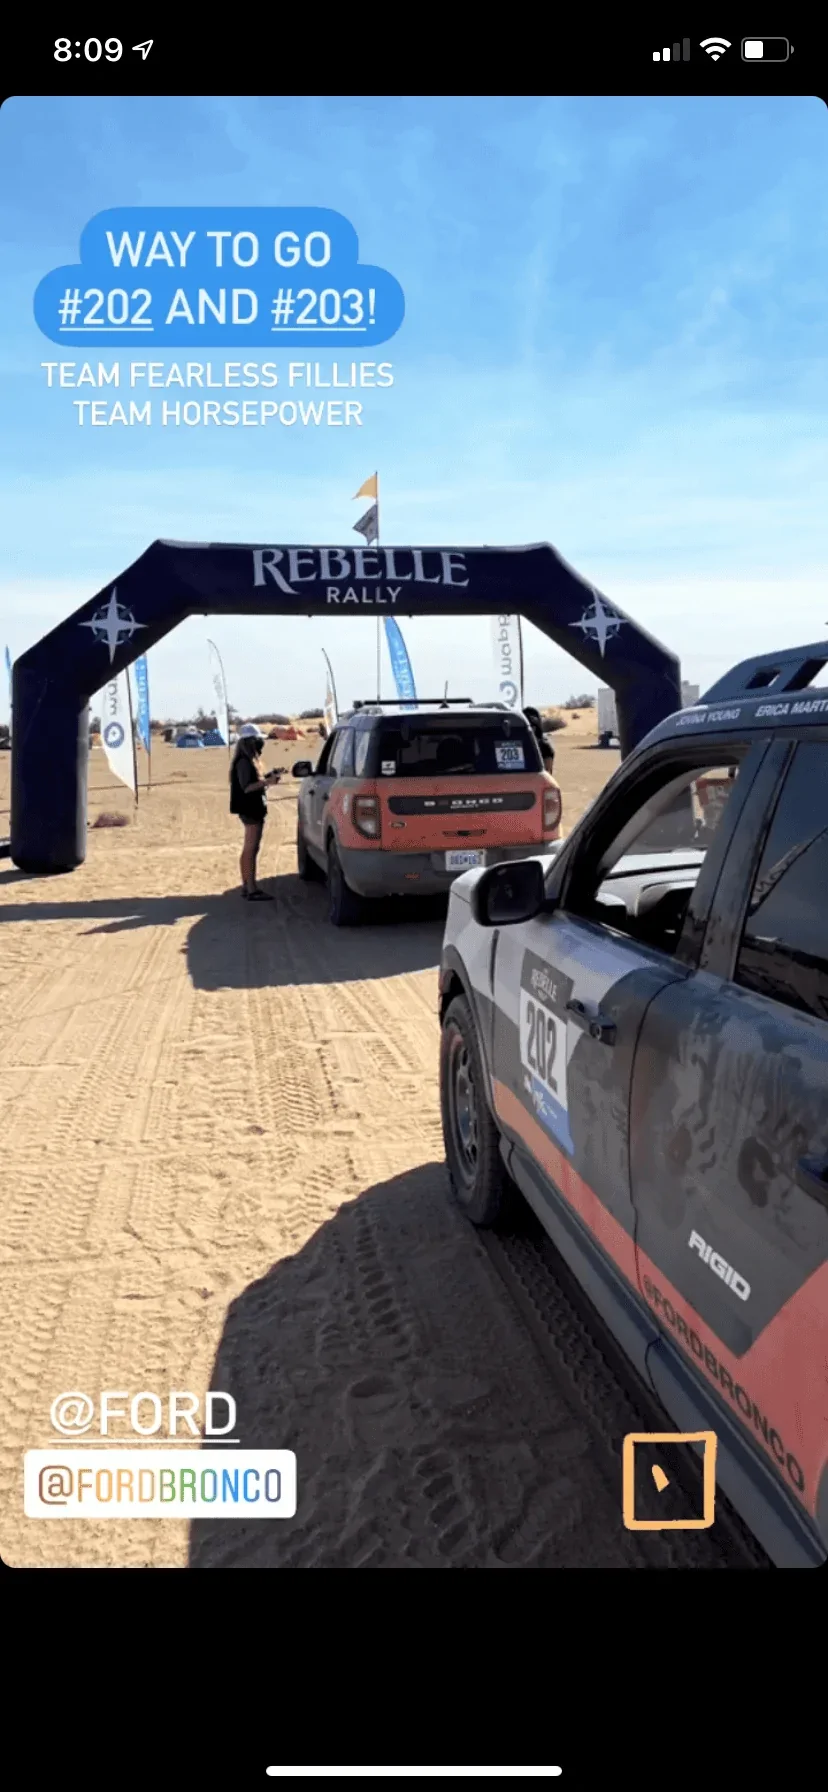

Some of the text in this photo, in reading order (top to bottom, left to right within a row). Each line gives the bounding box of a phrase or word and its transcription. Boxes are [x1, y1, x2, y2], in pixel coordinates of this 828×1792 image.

[252, 548, 469, 594] REBELLE
[326, 586, 402, 603] RALLY
[755, 702, 790, 717] ERICA
[501, 748, 519, 760] 203
[527, 1000, 557, 1095] 202
[688, 1229, 751, 1301] RIGID
[643, 1275, 805, 1492] @FORDBRONCO
